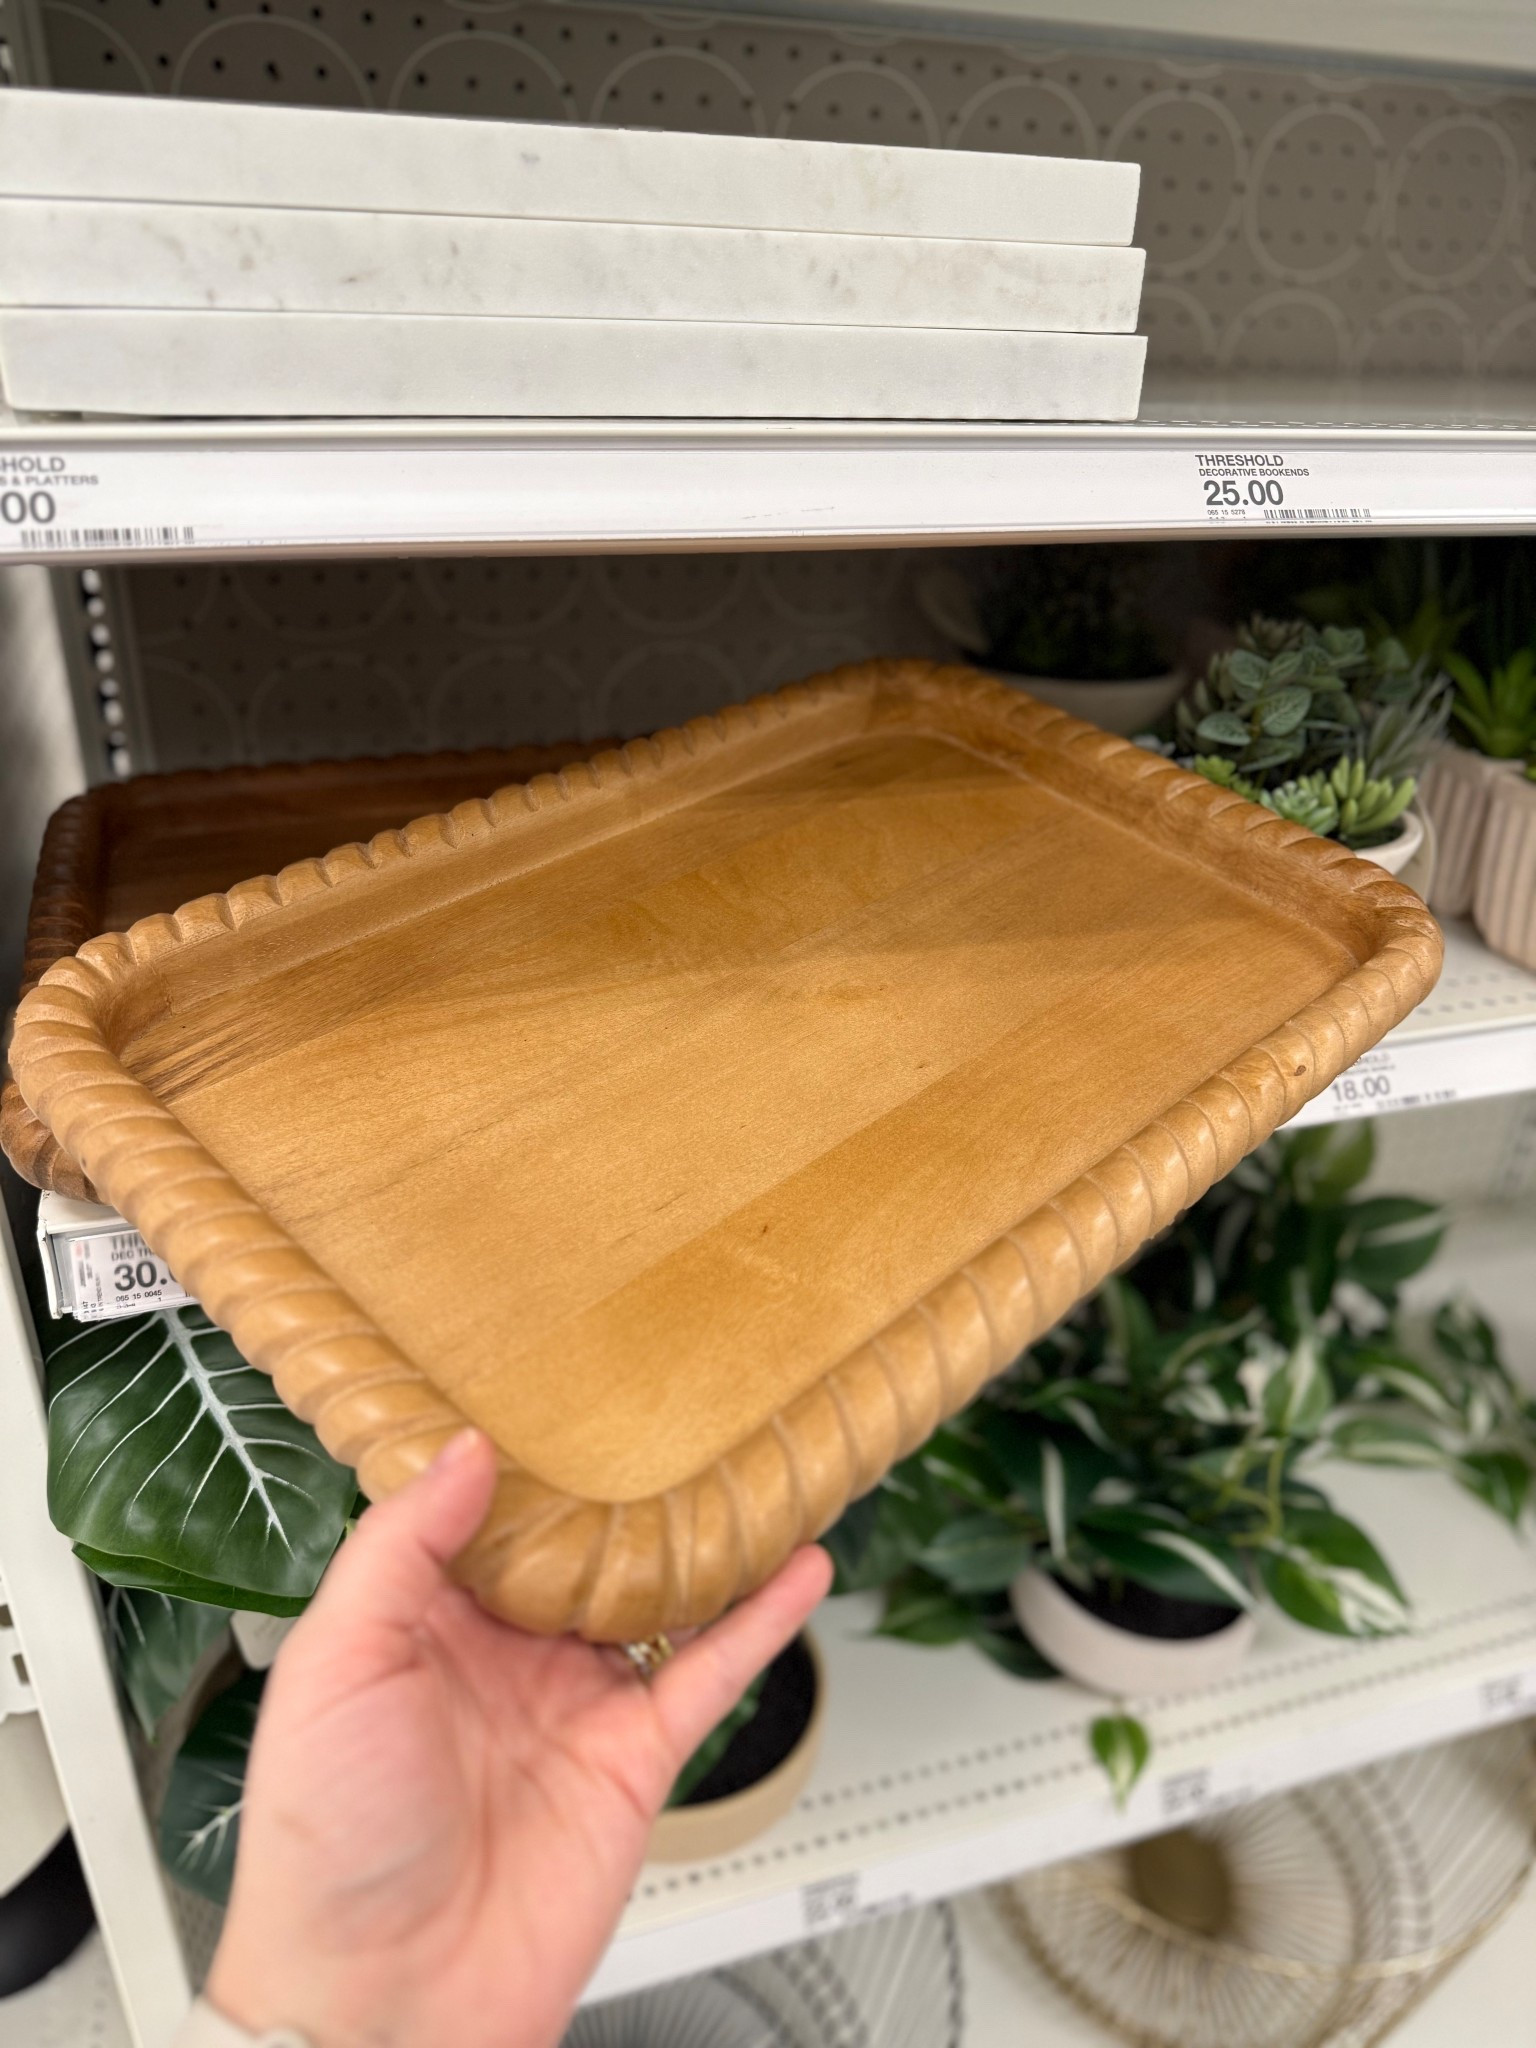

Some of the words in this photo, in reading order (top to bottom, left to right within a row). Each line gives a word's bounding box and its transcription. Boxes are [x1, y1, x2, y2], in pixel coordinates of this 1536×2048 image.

[0, 456, 66, 473] HOLD
[1194, 454, 1284, 467] THRESHOLD
[1198, 468, 1258, 477] DECORATIVE
[1259, 468, 1310, 477] BOOKENDS
[25, 475, 99, 486] PLATTERS
[1203, 480, 1284, 506] 25.00
[1331, 1074, 1392, 1103] 18.00
[115, 1294, 130, 1303] 065
[132, 1292, 142, 1301] 15
[144, 1289, 163, 1298] 0045
